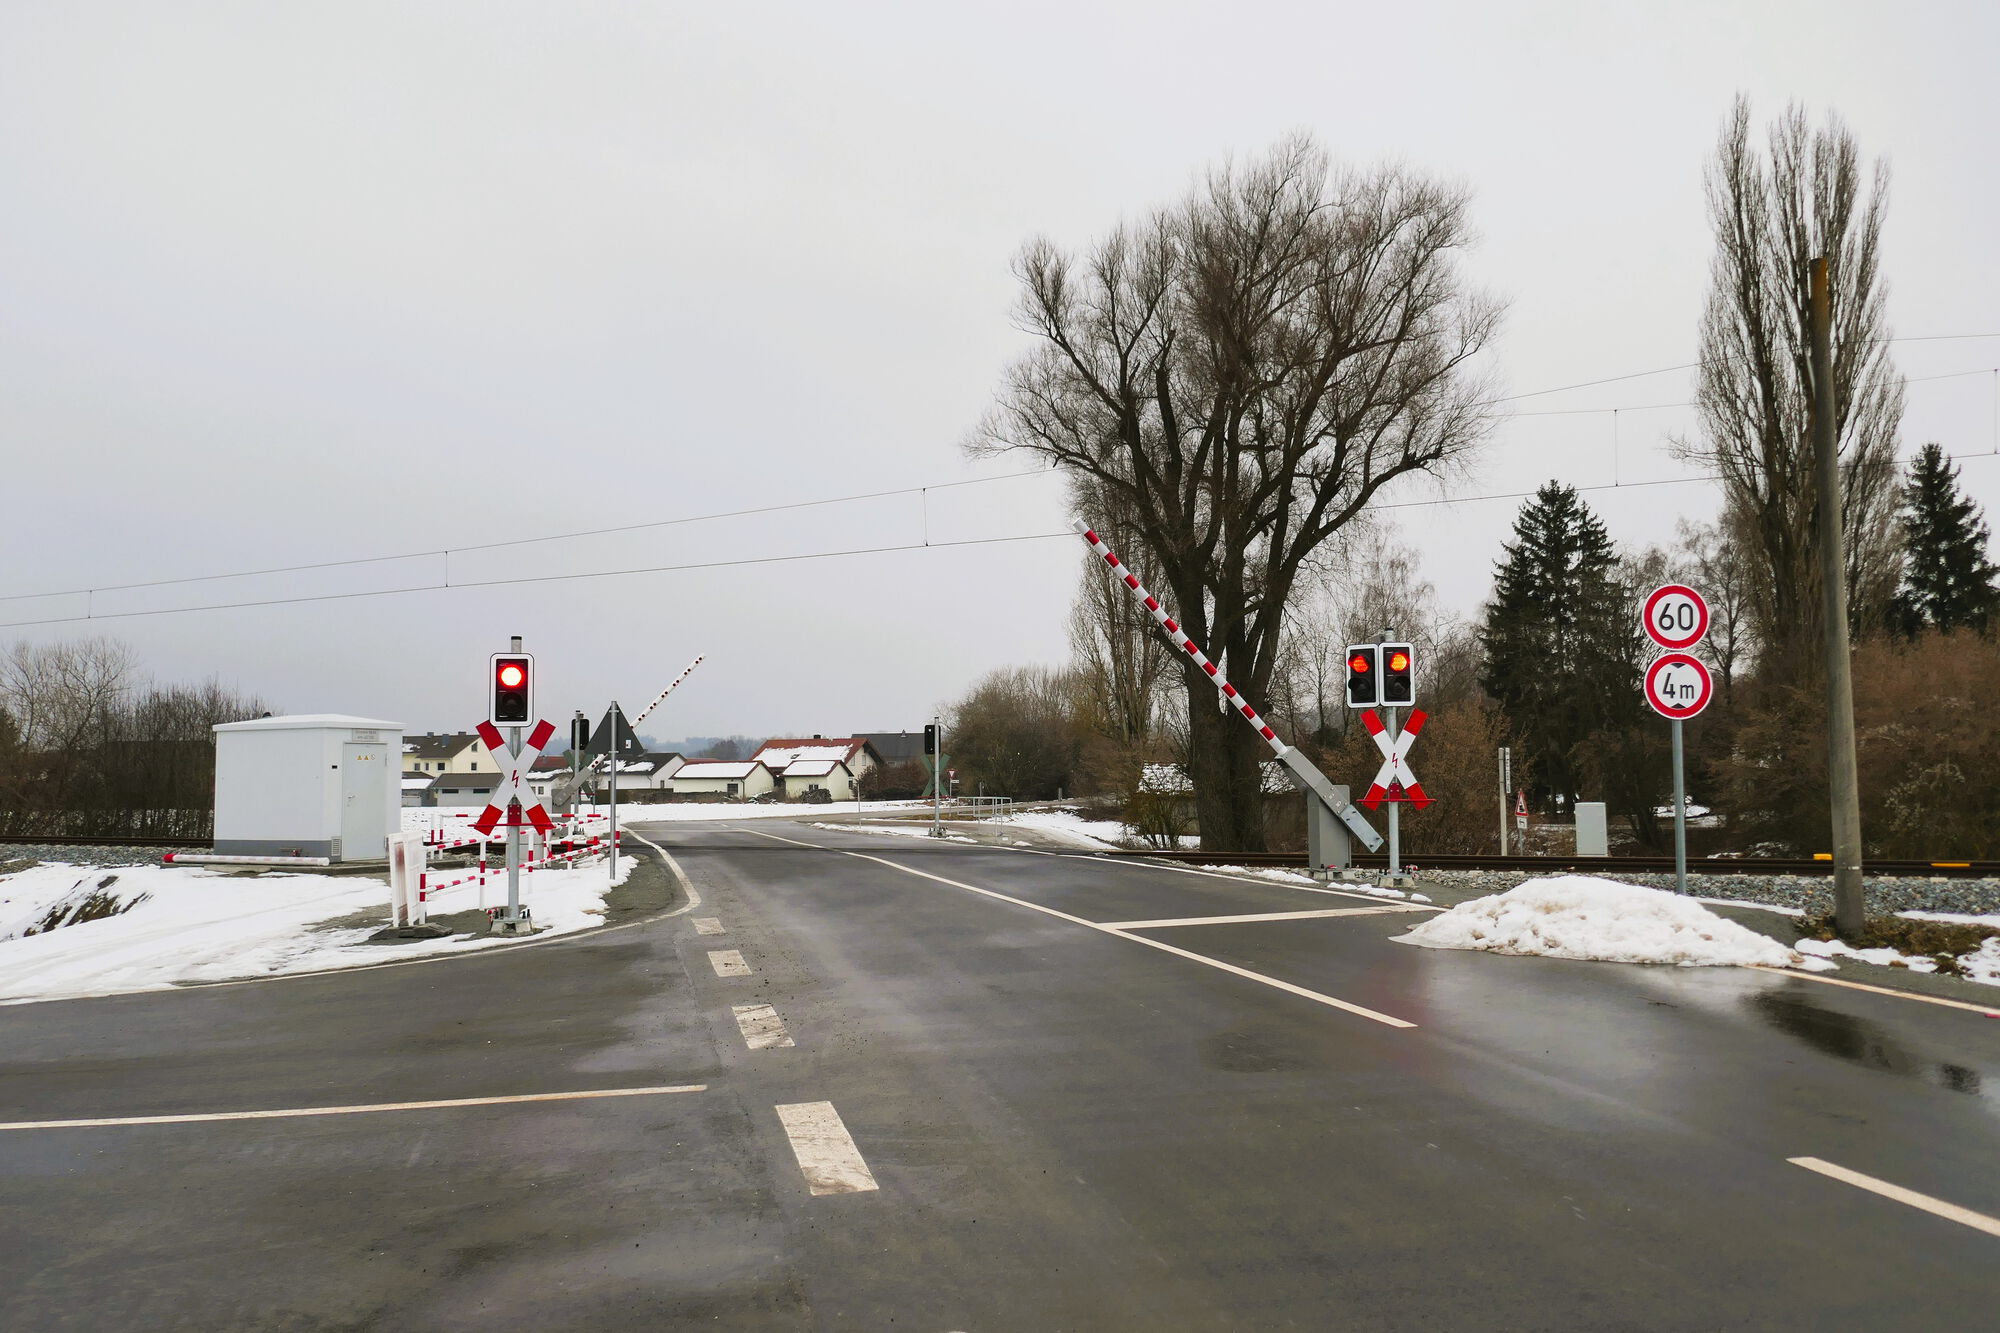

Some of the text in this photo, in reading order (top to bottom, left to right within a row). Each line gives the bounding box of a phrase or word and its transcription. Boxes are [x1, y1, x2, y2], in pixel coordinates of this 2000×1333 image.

[1659, 603, 1693, 631] 60
[1662, 672, 1695, 699] 4 m
